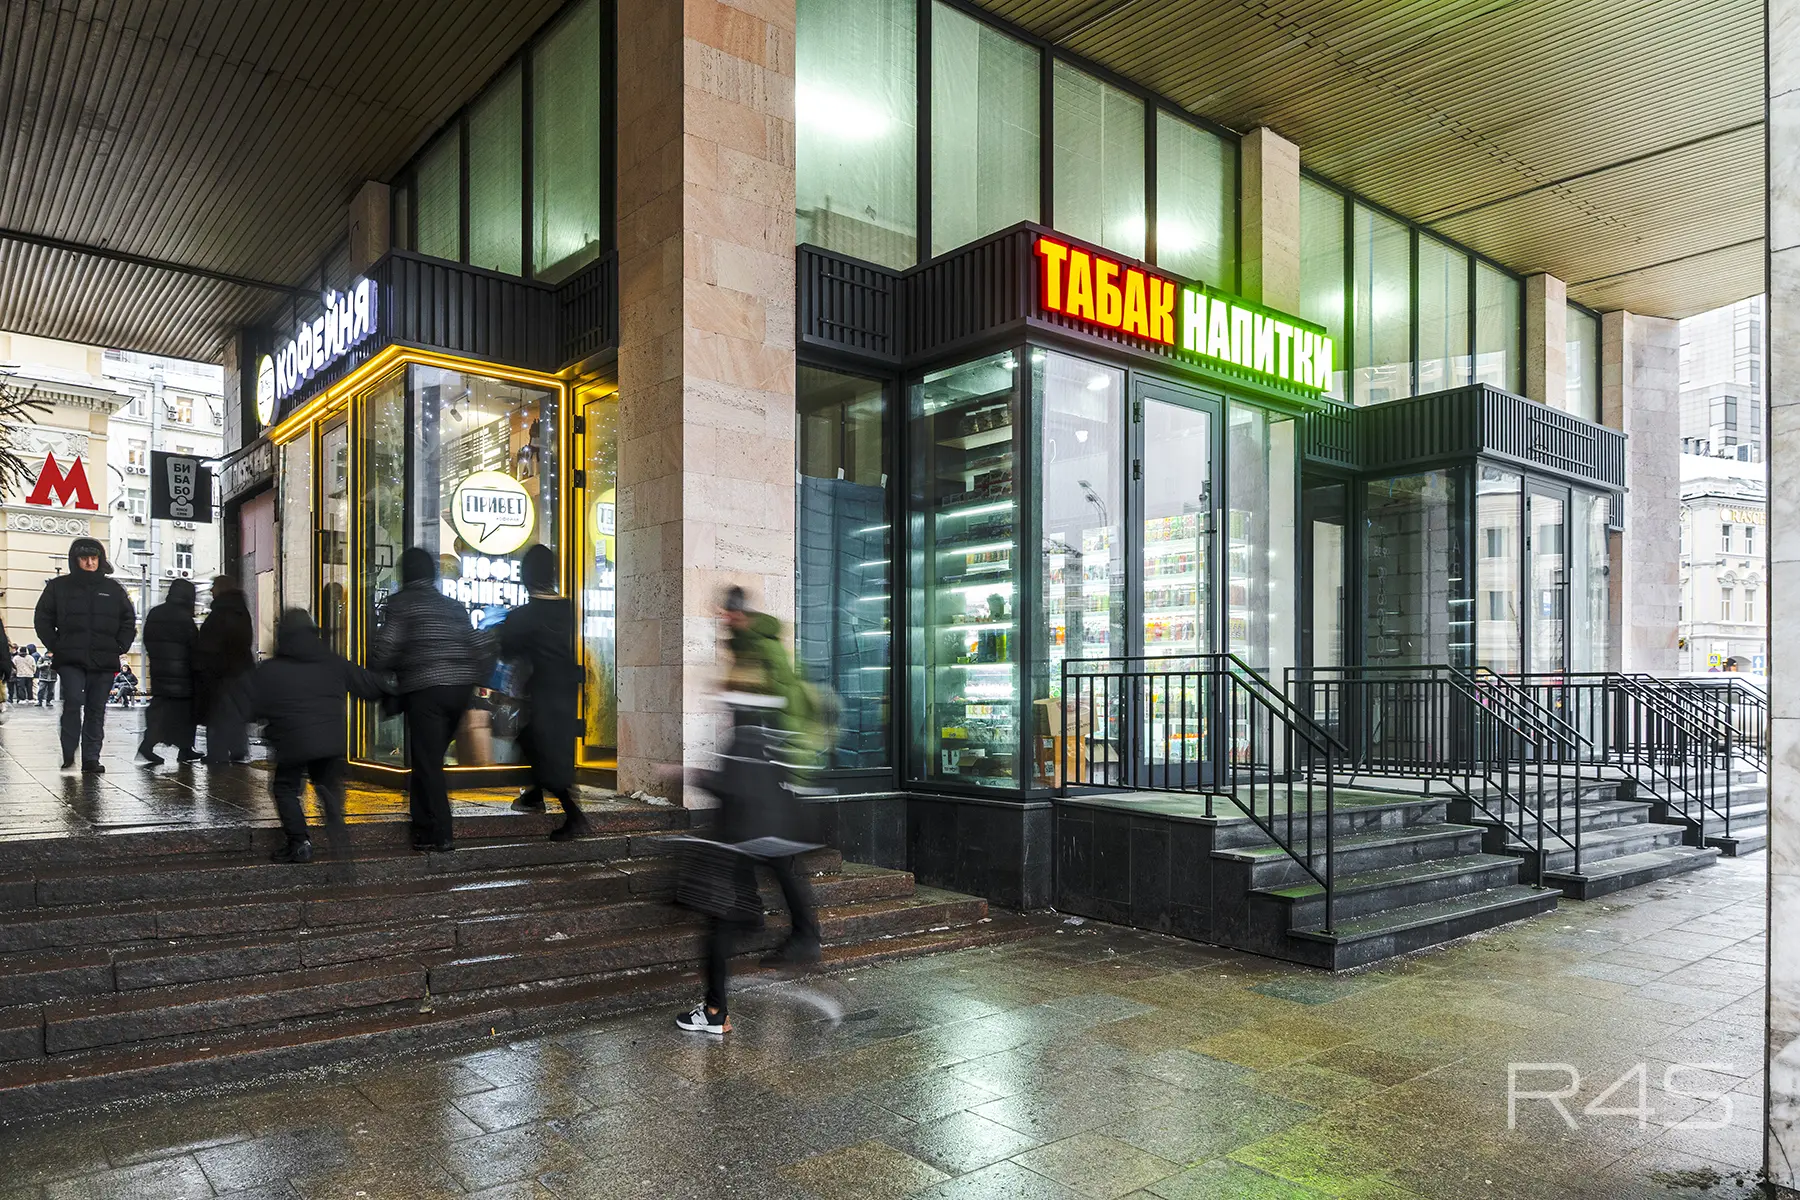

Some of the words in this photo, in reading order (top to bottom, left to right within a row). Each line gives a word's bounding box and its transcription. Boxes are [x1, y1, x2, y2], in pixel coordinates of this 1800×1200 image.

[1037, 237, 1176, 346] ТАБАК
[1183, 287, 1333, 392] НАПИТКИ
[276, 277, 370, 400] КОФЕЙНЯ
[173, 463, 191, 474] БИ
[174, 474, 191, 485] БА
[174, 485, 191, 496] БО
[466, 495, 523, 515] ПРИВЕТ
[462, 556, 521, 582] КОФЕ
[442, 579, 530, 606] ВЫПЕЧК
